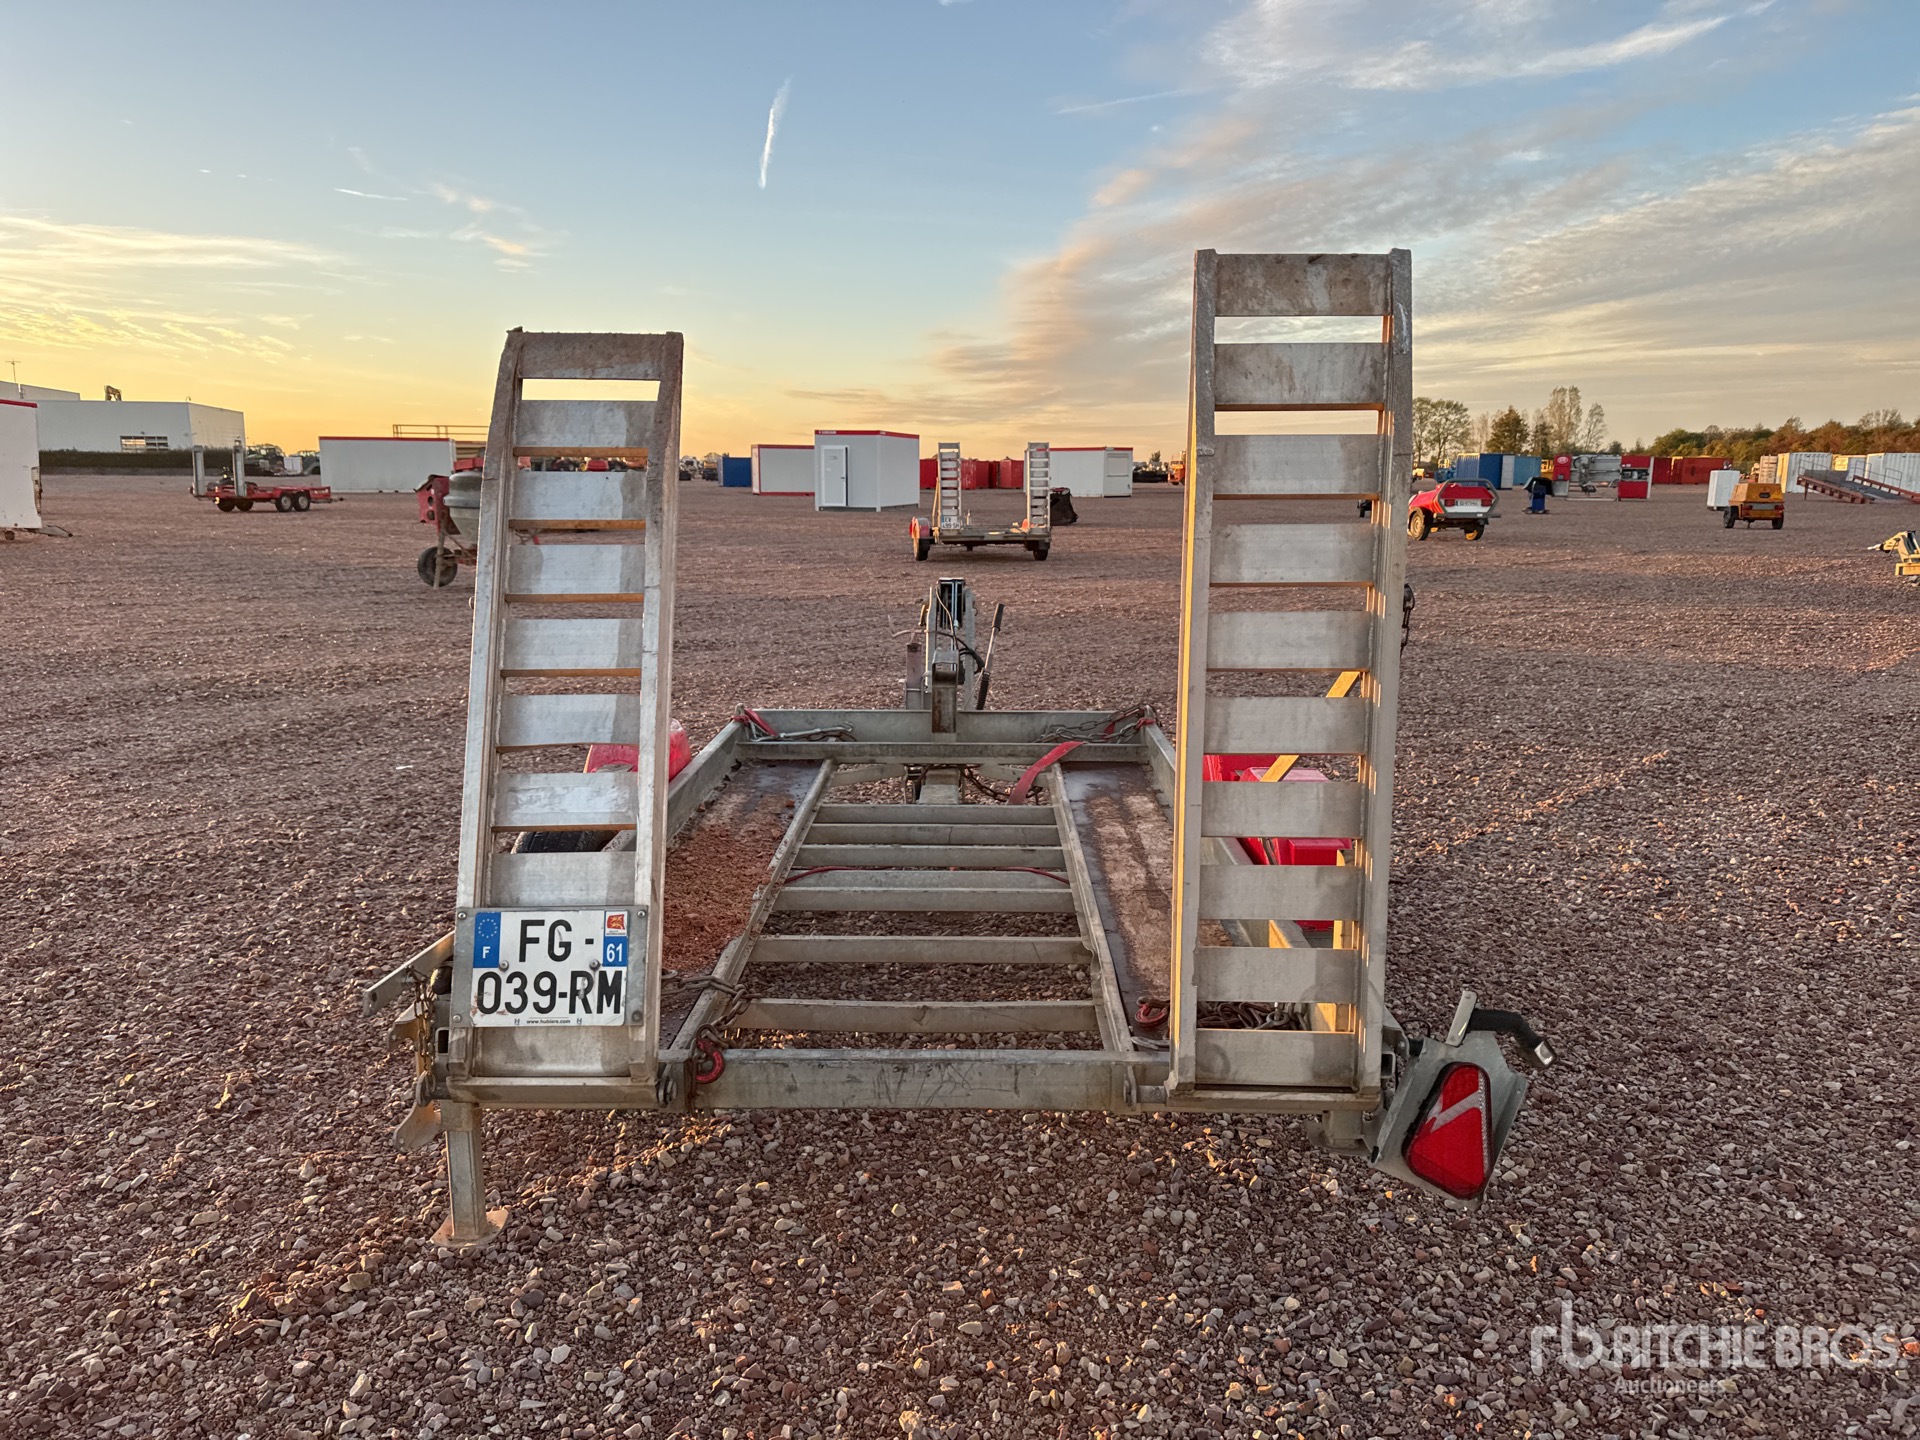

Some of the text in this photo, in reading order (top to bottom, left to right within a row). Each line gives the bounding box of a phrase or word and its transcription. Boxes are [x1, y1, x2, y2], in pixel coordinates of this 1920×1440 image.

[482, 946, 491, 959] F
[606, 943, 623, 963] 61
[477, 970, 623, 1015] 039-RM
